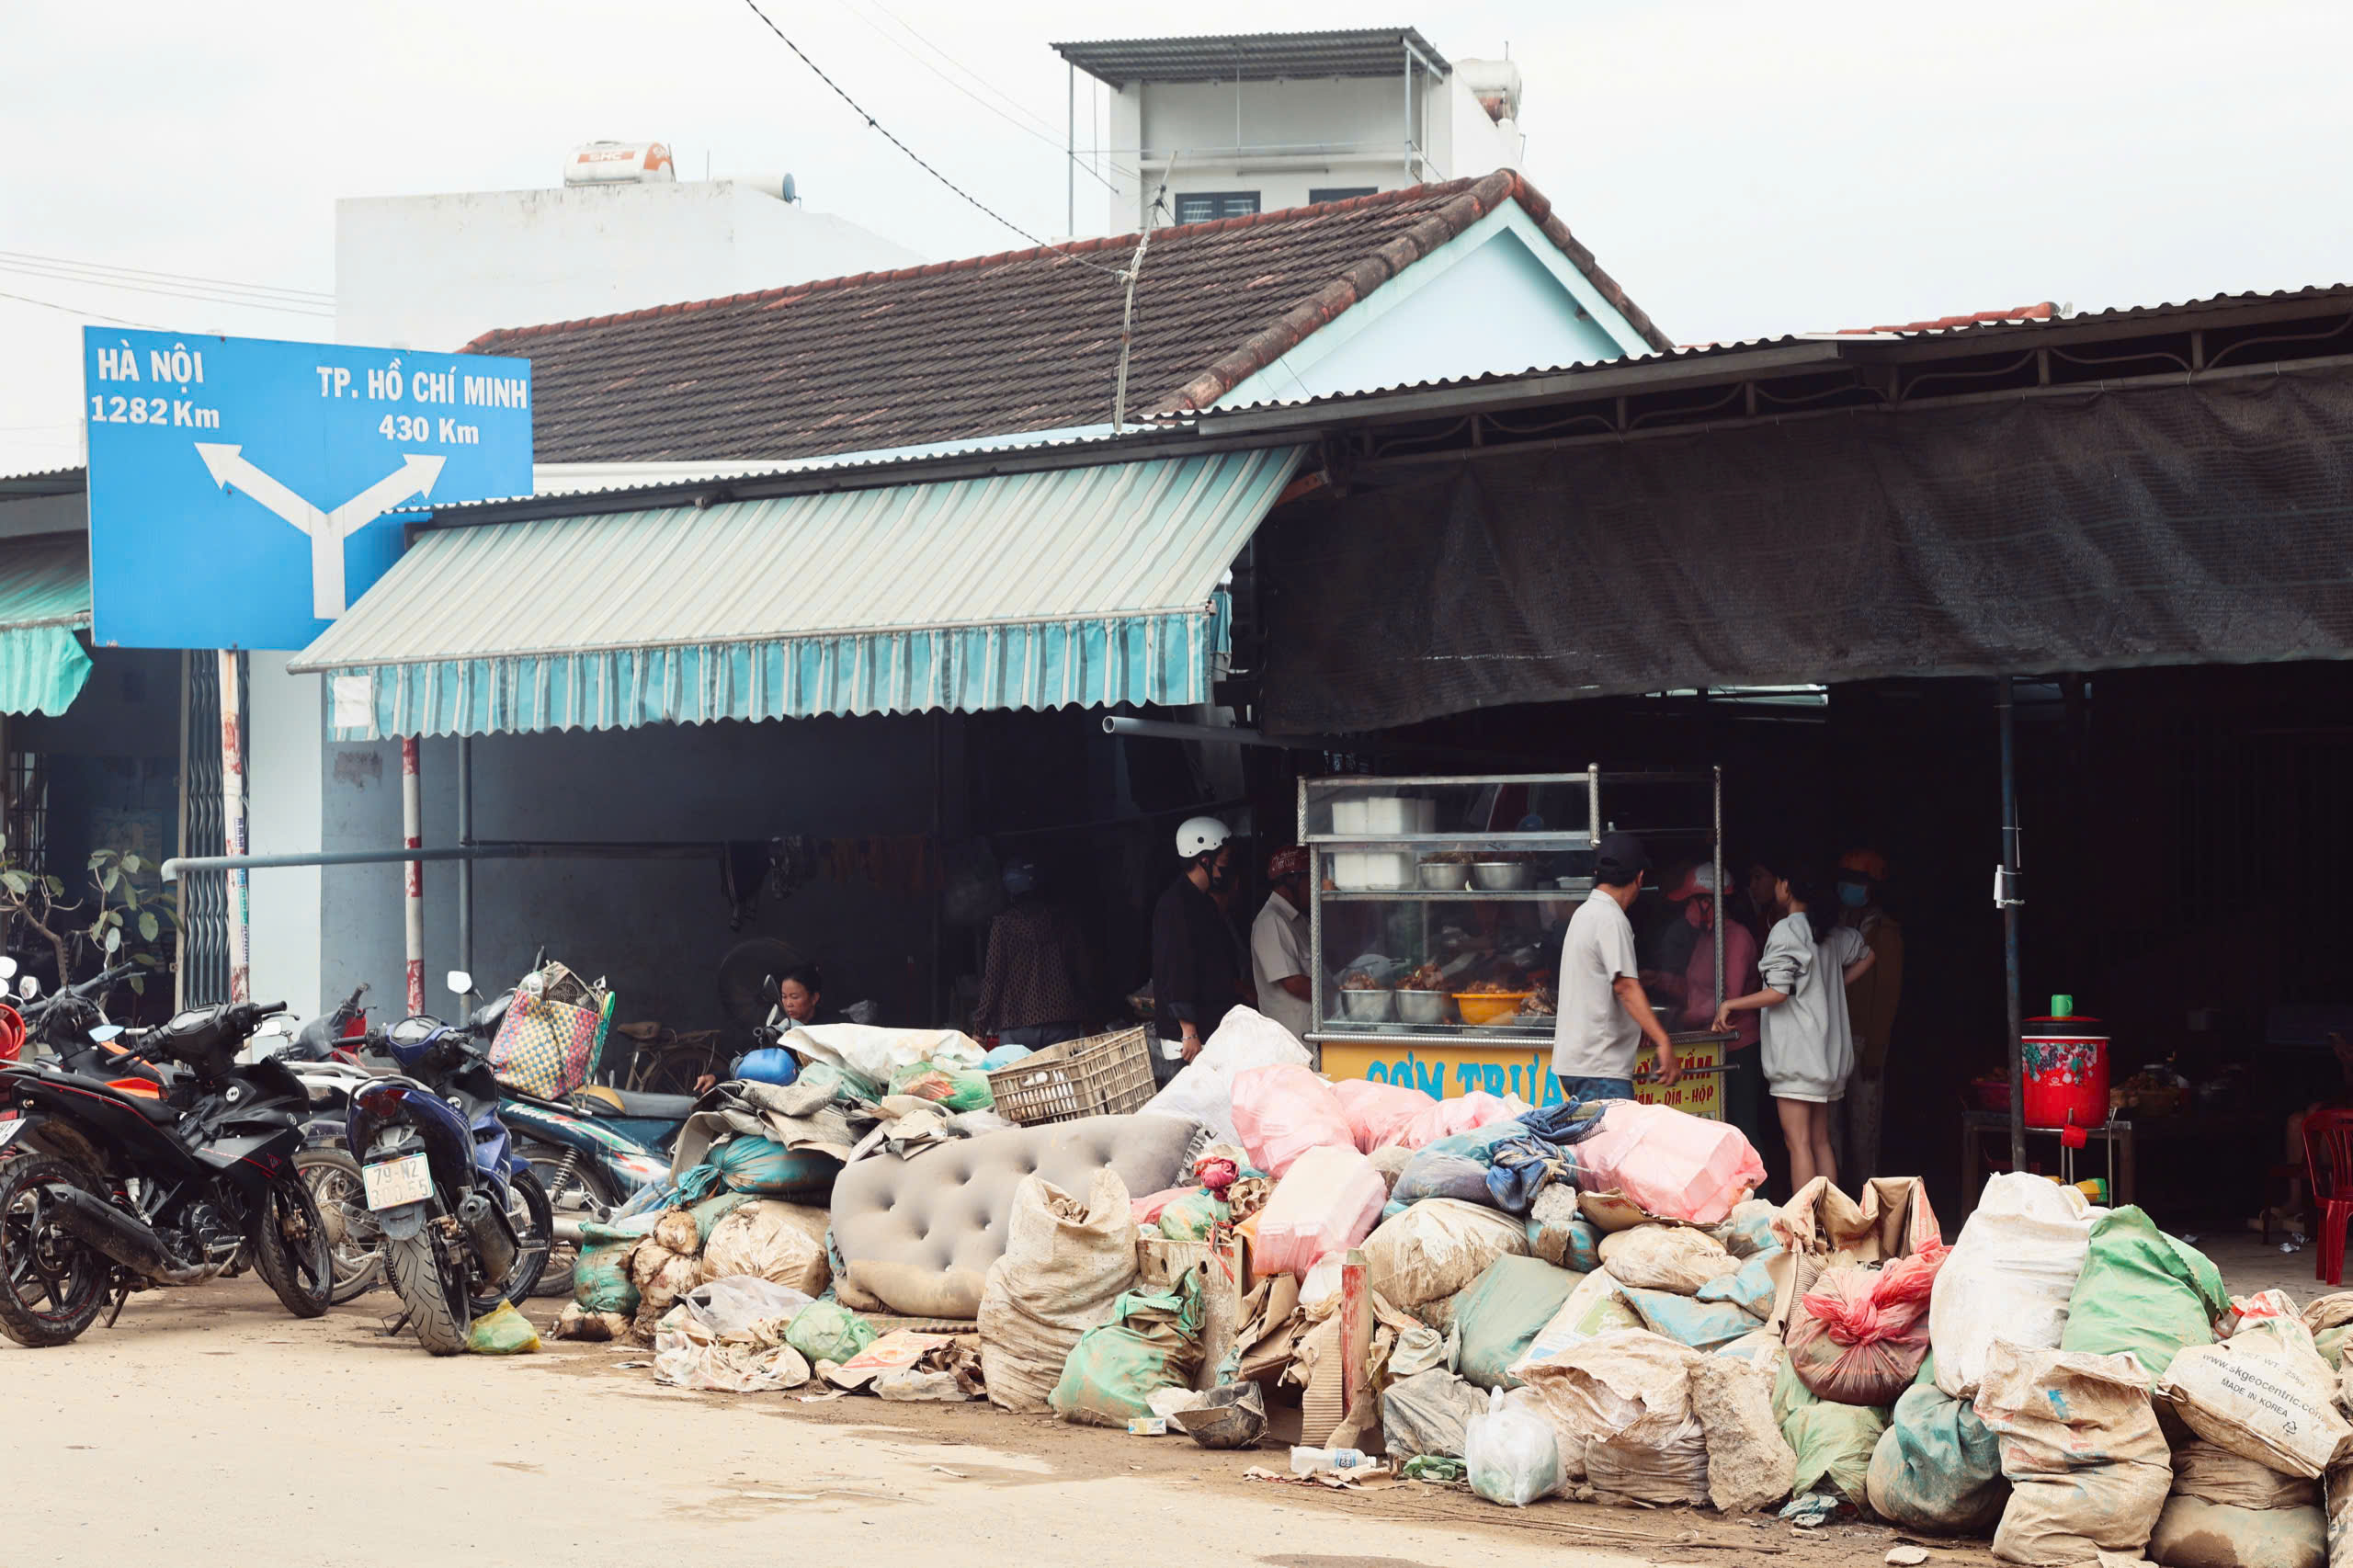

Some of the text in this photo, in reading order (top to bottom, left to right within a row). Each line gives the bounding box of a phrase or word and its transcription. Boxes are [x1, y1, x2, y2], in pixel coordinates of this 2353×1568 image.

[97, 339, 204, 393] HÀ NỘI
[316, 358, 528, 409] TP. HỒ CHÍ MINH
[91, 394, 221, 429] 1282 Km
[379, 414, 480, 445] 430 Km
[2202, 1353, 2325, 1422] www.skgeocentric.com
[2221, 1378, 2289, 1417] MADE IN KOREA
